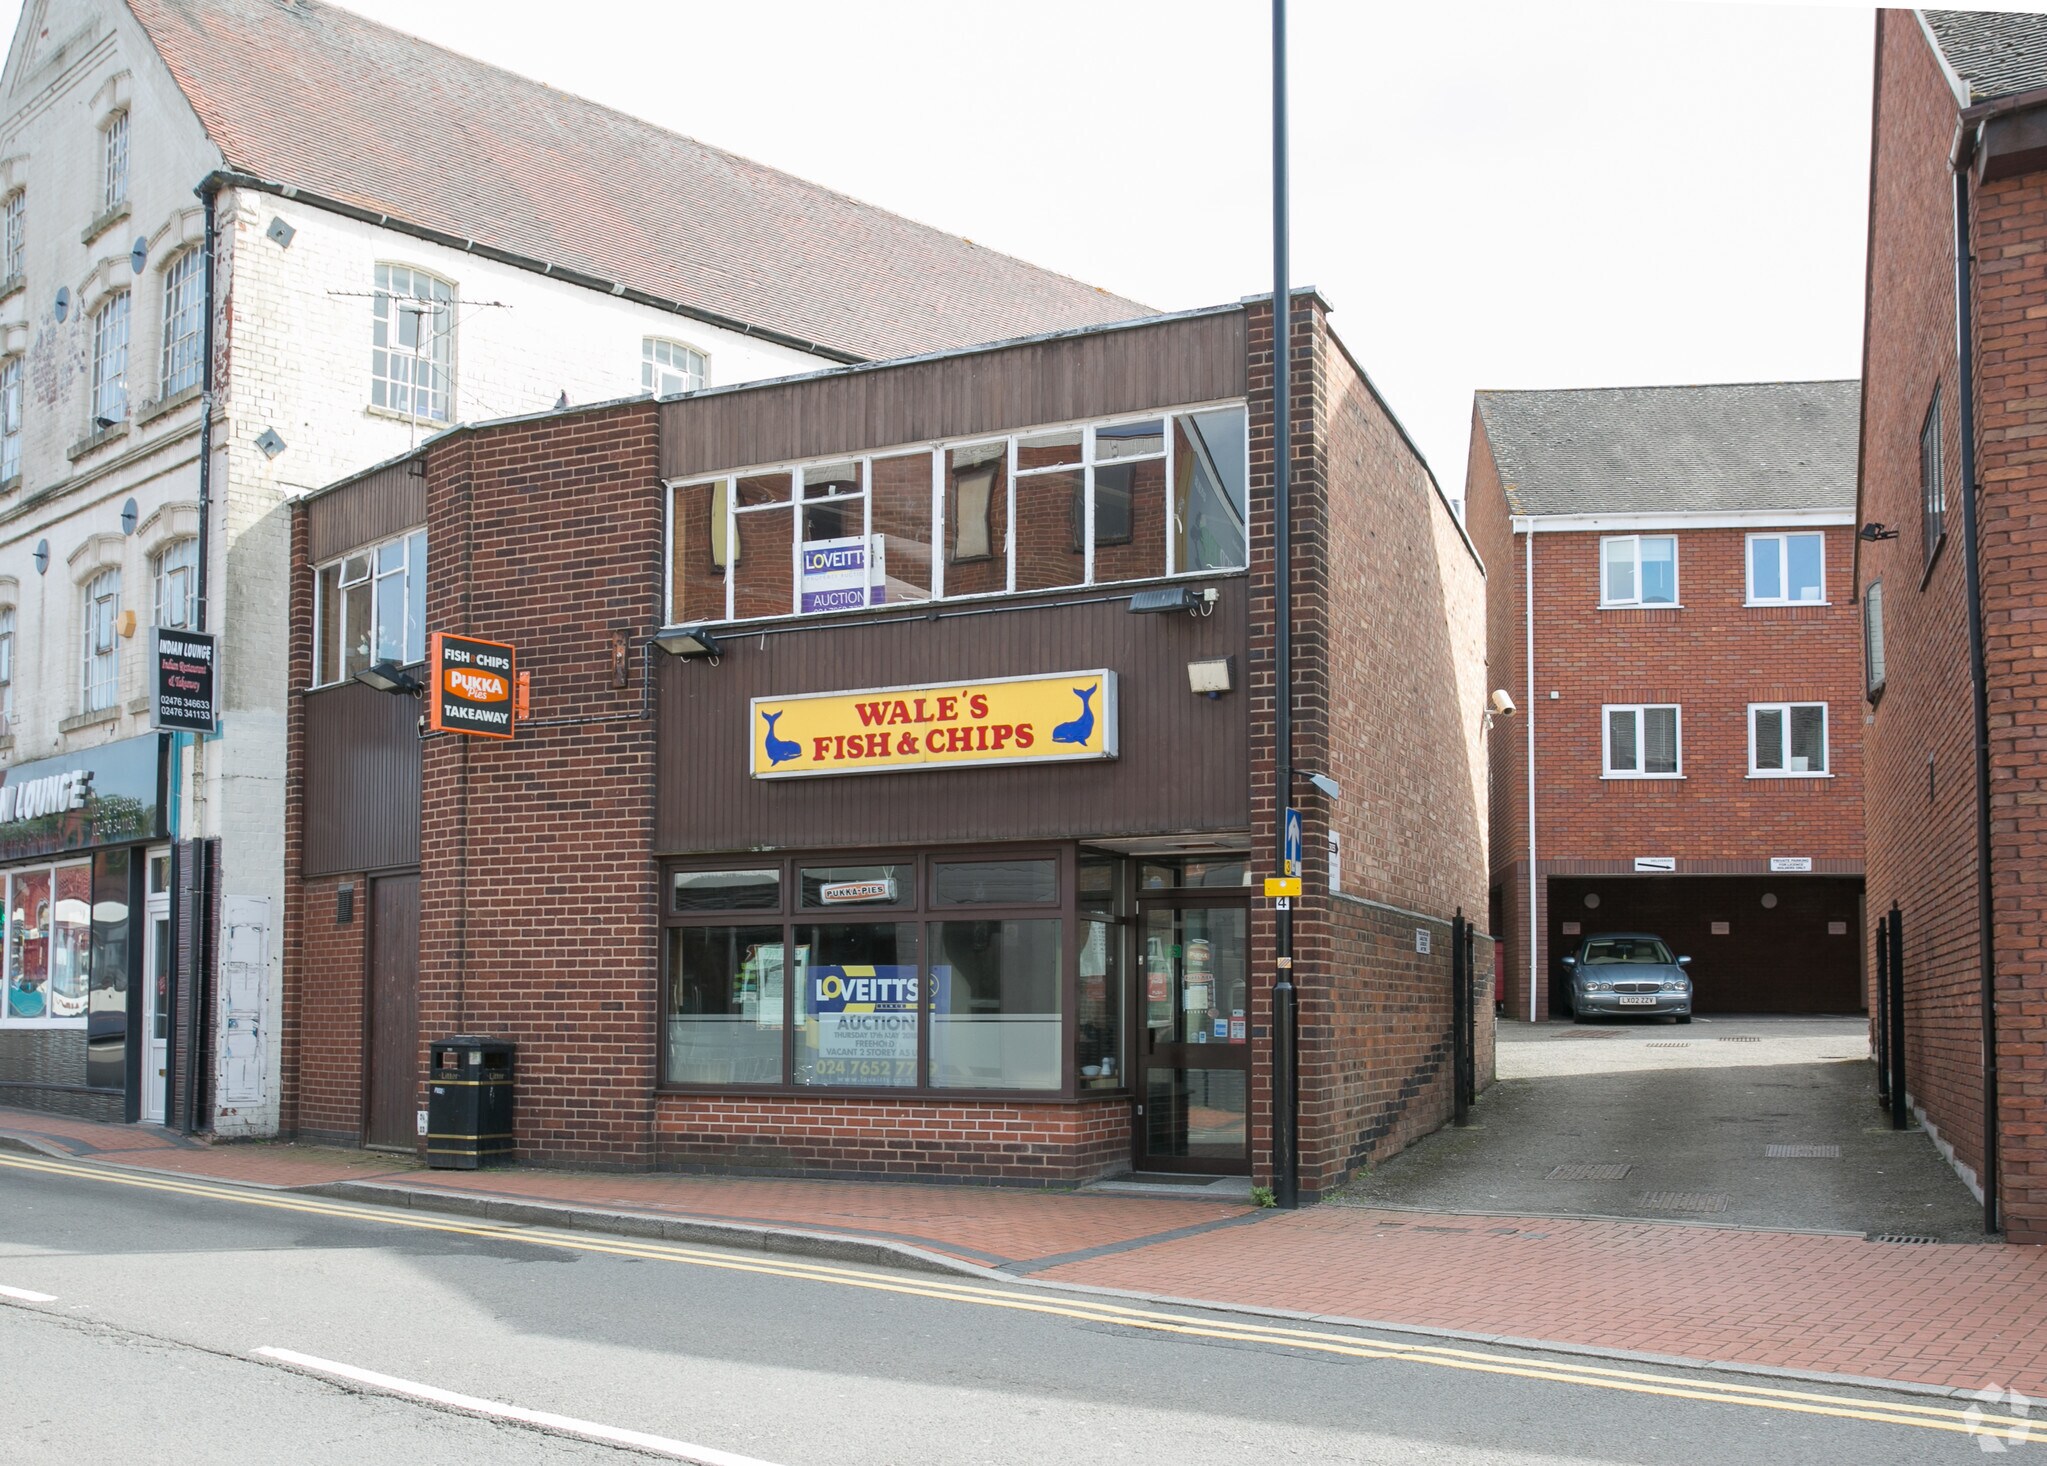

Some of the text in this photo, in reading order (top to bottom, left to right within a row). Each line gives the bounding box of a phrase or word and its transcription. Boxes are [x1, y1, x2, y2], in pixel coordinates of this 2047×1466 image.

[160, 639, 211, 661] INDIAN LOUNGE
[162, 658, 207, 675] Indian Restaurant
[444, 648, 470, 663] FISH
[476, 654, 509, 670] CHIPS
[451, 671, 503, 695] PUKKA
[468, 686, 487, 700] Pies
[160, 695, 210, 710] 02476 346633
[855, 689, 989, 727] WALE'S
[160, 706, 210, 720] 02476 341133
[444, 704, 509, 724] TAKEAWAY
[812, 731, 892, 761] FISH
[925, 723, 1034, 753] CHIPS
[15, 769, 91, 820] LOUNGE
[826, 886, 883, 897] PUKKA-PIES
[1278, 897, 1287, 908] 4
[816, 976, 918, 1002] LOVEITTS
[837, 1015, 916, 1031] AUCTION
[834, 1031, 868, 1039] THURSDAY
[826, 1048, 857, 1056] VACANT
[859, 1048, 865, 1056] 2
[866, 1048, 897, 1056] STOREY
[441, 1072, 458, 1080] Litter
[816, 1060, 846, 1075] 024
[850, 1060, 891, 1076] 7652
